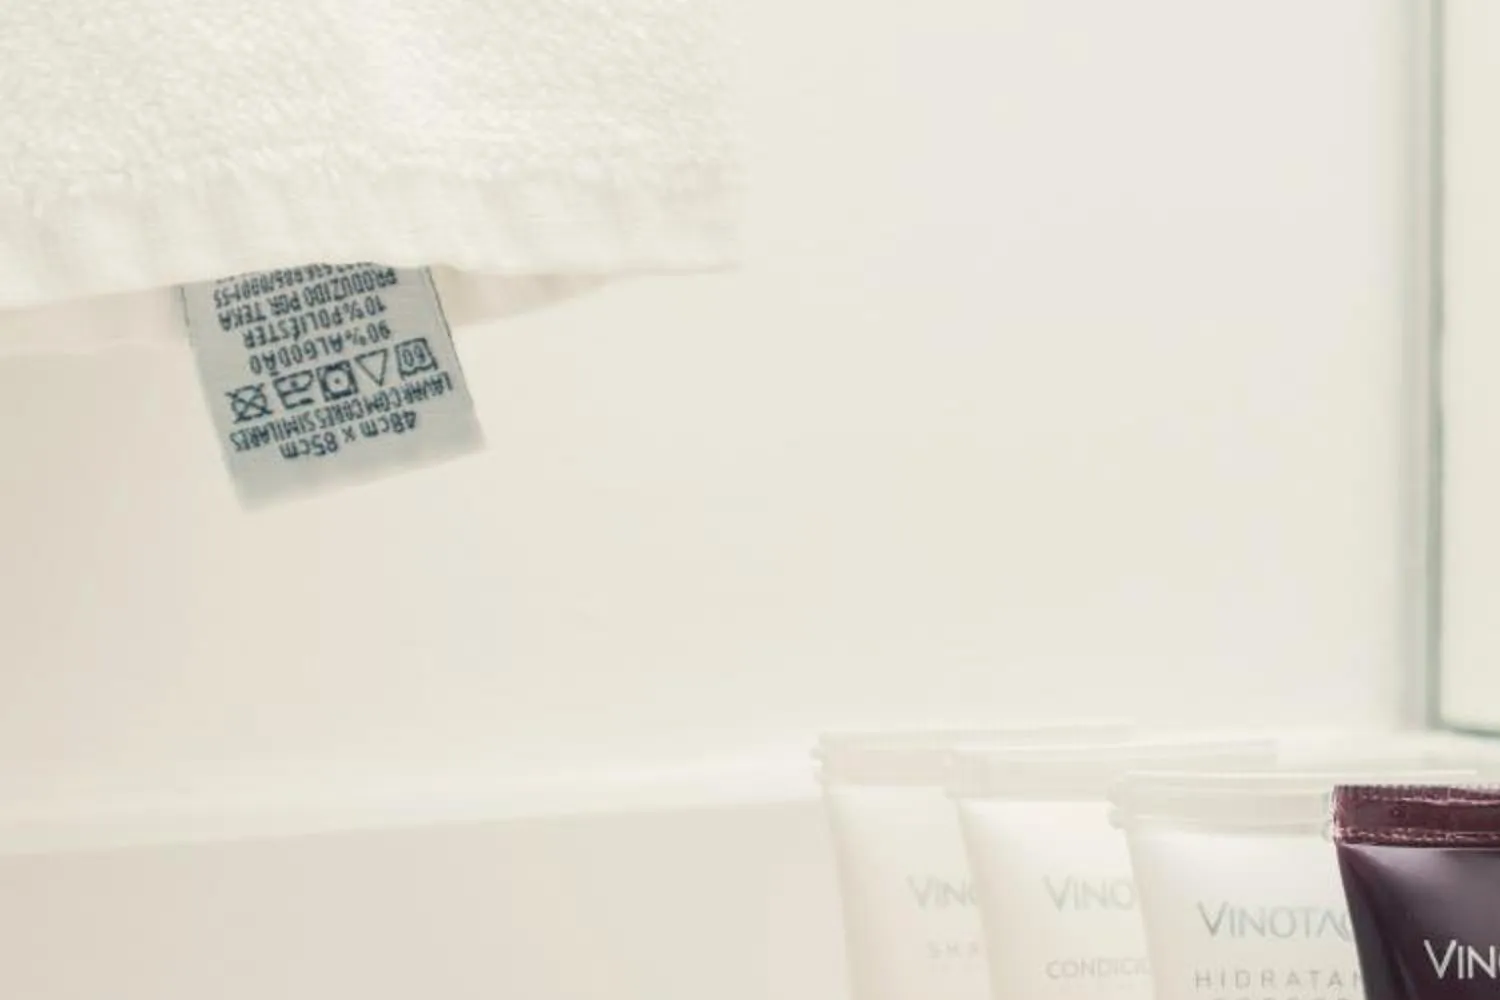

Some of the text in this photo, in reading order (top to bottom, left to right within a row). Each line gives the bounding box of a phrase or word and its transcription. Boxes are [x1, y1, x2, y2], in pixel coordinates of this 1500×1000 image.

[302, 267, 398, 308] PRODUZIDO
[217, 301, 267, 332] TEKA
[279, 410, 418, 460] 48cm x 85cm
